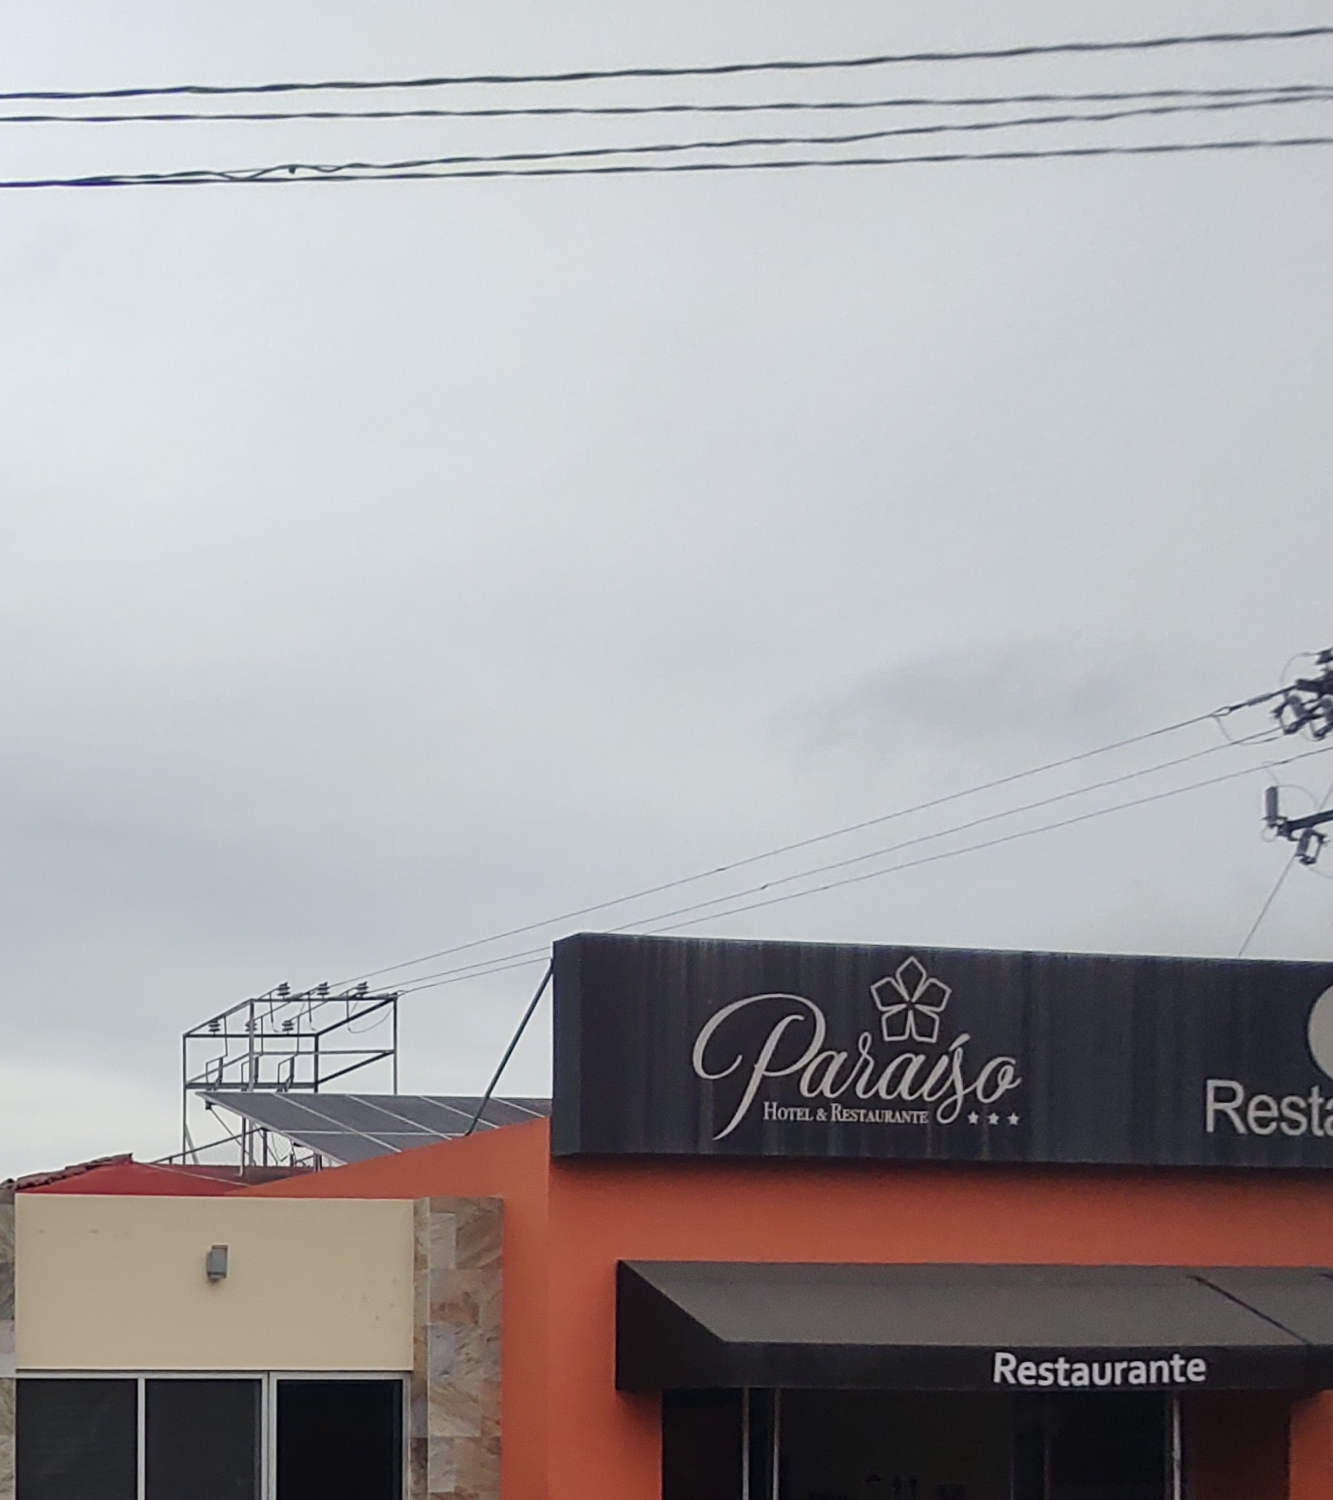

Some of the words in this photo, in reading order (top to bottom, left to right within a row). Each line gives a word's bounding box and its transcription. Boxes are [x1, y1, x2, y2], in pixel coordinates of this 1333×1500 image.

[763, 1102, 814, 1122] HOTEL
[816, 1109, 828, 1121] &
[830, 1103, 929, 1125] RESTAURANTE
[993, 1352, 1207, 1387] Restaurante
